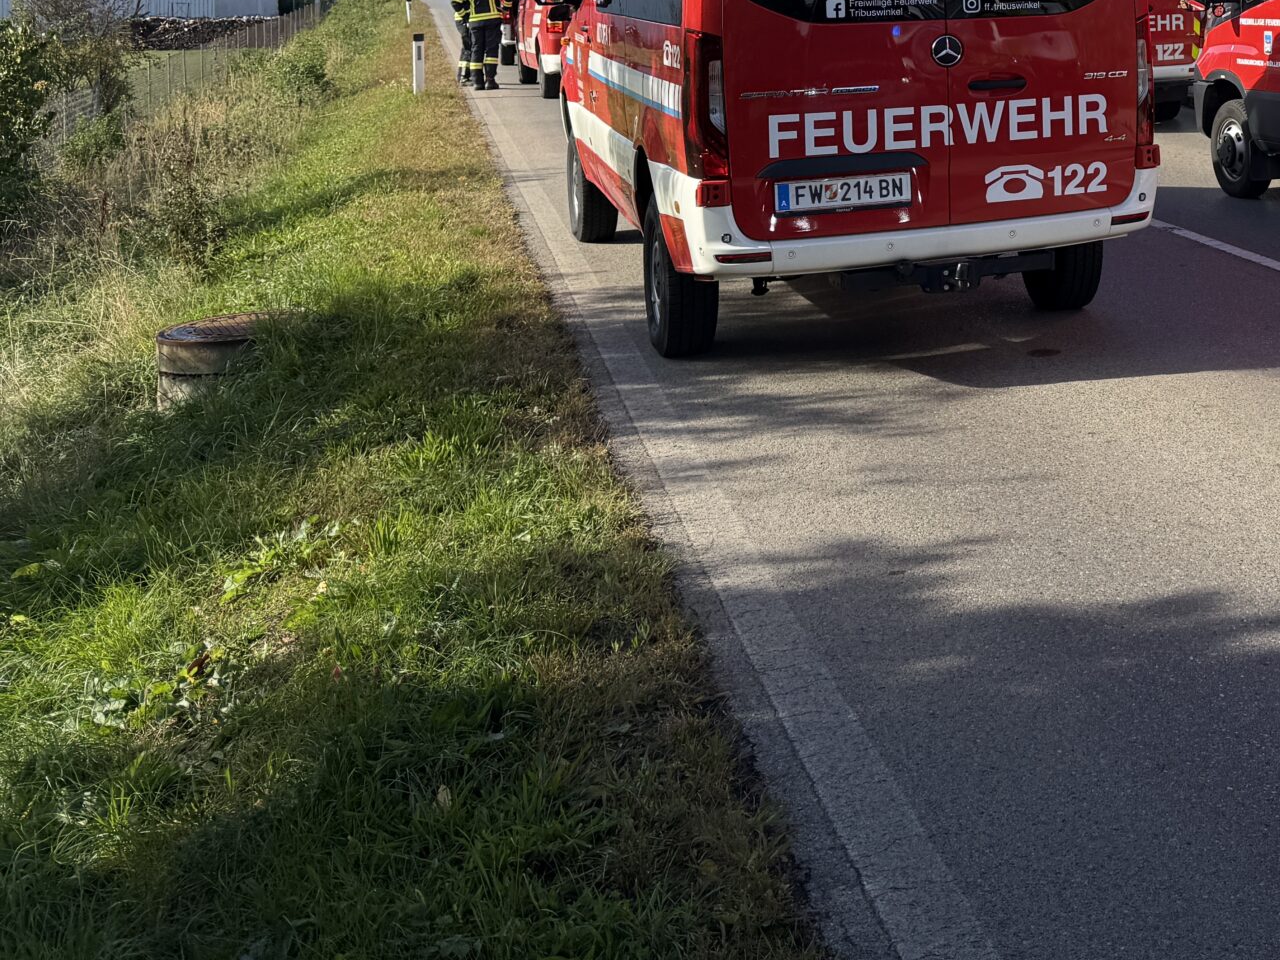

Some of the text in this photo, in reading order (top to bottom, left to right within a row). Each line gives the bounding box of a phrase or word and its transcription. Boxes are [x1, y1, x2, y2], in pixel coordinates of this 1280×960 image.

[850, 7, 904, 17] Tribuswinkel
[1155, 42, 1185, 61] 122
[768, 93, 1108, 159] FEUERWEHR
[795, 177, 903, 206] FW 214 BN
[1047, 161, 1107, 197] 122
